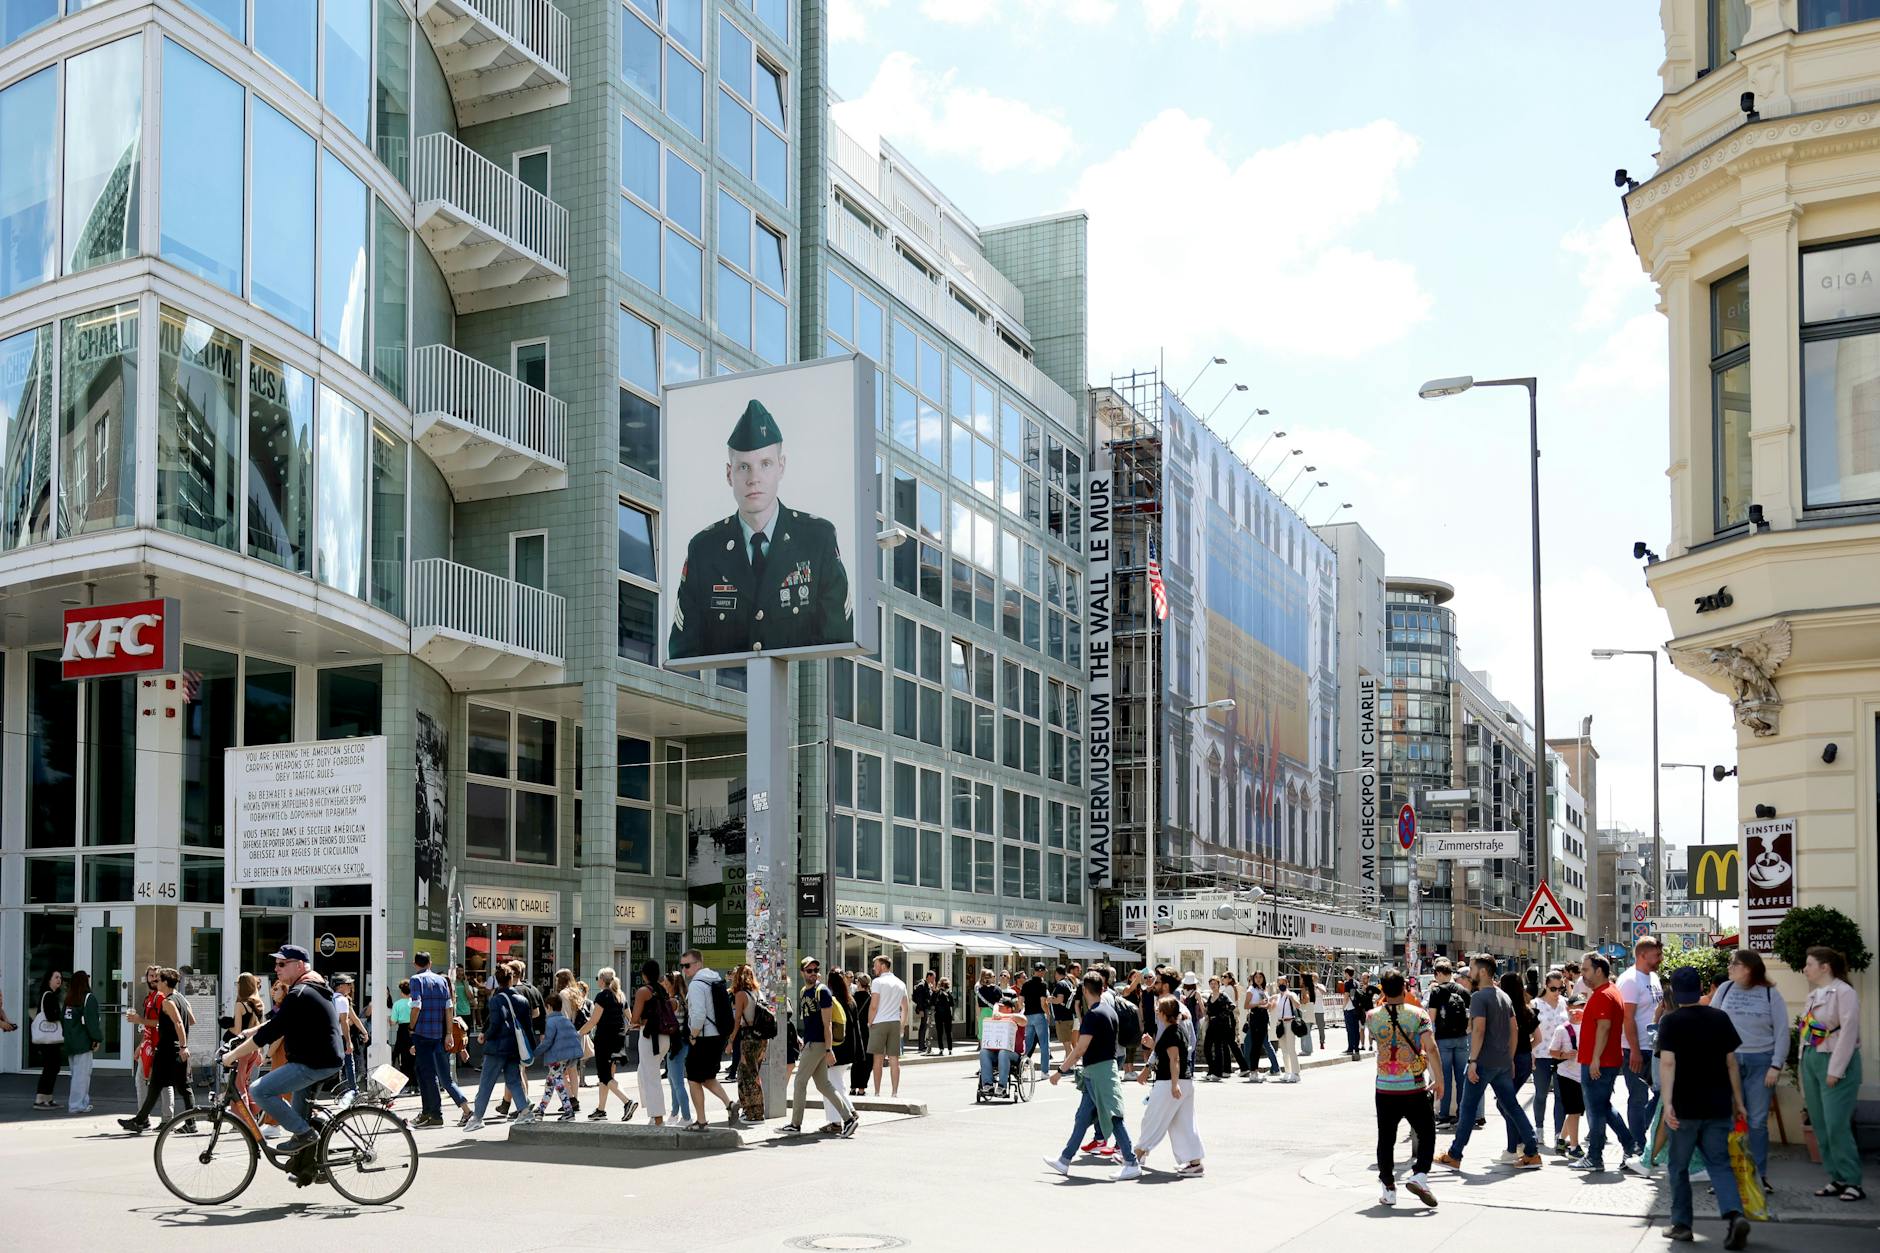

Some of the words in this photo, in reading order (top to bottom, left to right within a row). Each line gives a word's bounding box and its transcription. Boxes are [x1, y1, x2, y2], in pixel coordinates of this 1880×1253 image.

[1821, 270, 1872, 289] GIGA
[1090, 479, 1109, 532] MUR
[1090, 539, 1109, 562] LE
[1090, 573, 1109, 636] WALL
[60, 613, 161, 662] KFC
[1090, 641, 1109, 682] THE
[1361, 680, 1374, 745] CHARLIE
[246, 753, 257, 762] YOU
[260, 751, 270, 760] ARE
[272, 749, 298, 760] ENTERING
[301, 748, 310, 757] THE
[312, 746, 340, 756] AMERICAN
[344, 744, 365, 754] SECTOR
[246, 762, 273, 773] CARRYING
[275, 760, 302, 771] WEAPONS
[304, 760, 314, 768] OFF
[317, 758, 330, 768] DUTY
[333, 756, 365, 766] FORBIDDEN
[276, 772, 290, 782] OBEY
[292, 770, 314, 780] TRAFFIC
[317, 769, 334, 778] RULES
[1090, 693, 1110, 879] MAUERMUSEUM
[244, 830, 257, 838] VOUS
[260, 828, 279, 838] ENTREZ
[282, 827, 296, 836] DANS
[300, 827, 306, 835] LE
[308, 825, 331, 835] SECTEUR
[1746, 823, 1793, 835] EINSTEIN
[312, 836, 318, 845] EN
[320, 836, 338, 845] DEHORS
[339, 835, 345, 844] DU
[347, 834, 366, 844] SERVICE
[1438, 839, 1504, 852] Zimmerstraße
[278, 849, 289, 858] AUX
[314, 847, 320, 856] DE
[323, 845, 358, 856] CIRCULATION
[254, 866, 279, 877] BETRETEN
[281, 866, 291, 876] DEN
[294, 864, 341, 876] AMERIKANISCHEN
[344, 863, 365, 873] SEKTOR
[728, 868, 746, 879] CO
[1361, 855, 1375, 881] AM
[158, 882, 176, 898] 45
[473, 896, 518, 911] CHECKPOINT
[521, 900, 549, 912] CHARLIE
[1749, 896, 1792, 906] KAFFEE
[615, 905, 635, 917] SCAFE
[837, 904, 858, 916] ECKPOINT
[860, 906, 878, 918] CHARLIE
[1178, 910, 1188, 920] US
[1190, 909, 1208, 920] ARMY
[693, 928, 716, 936] MAUER
[337, 941, 358, 949] CASH
